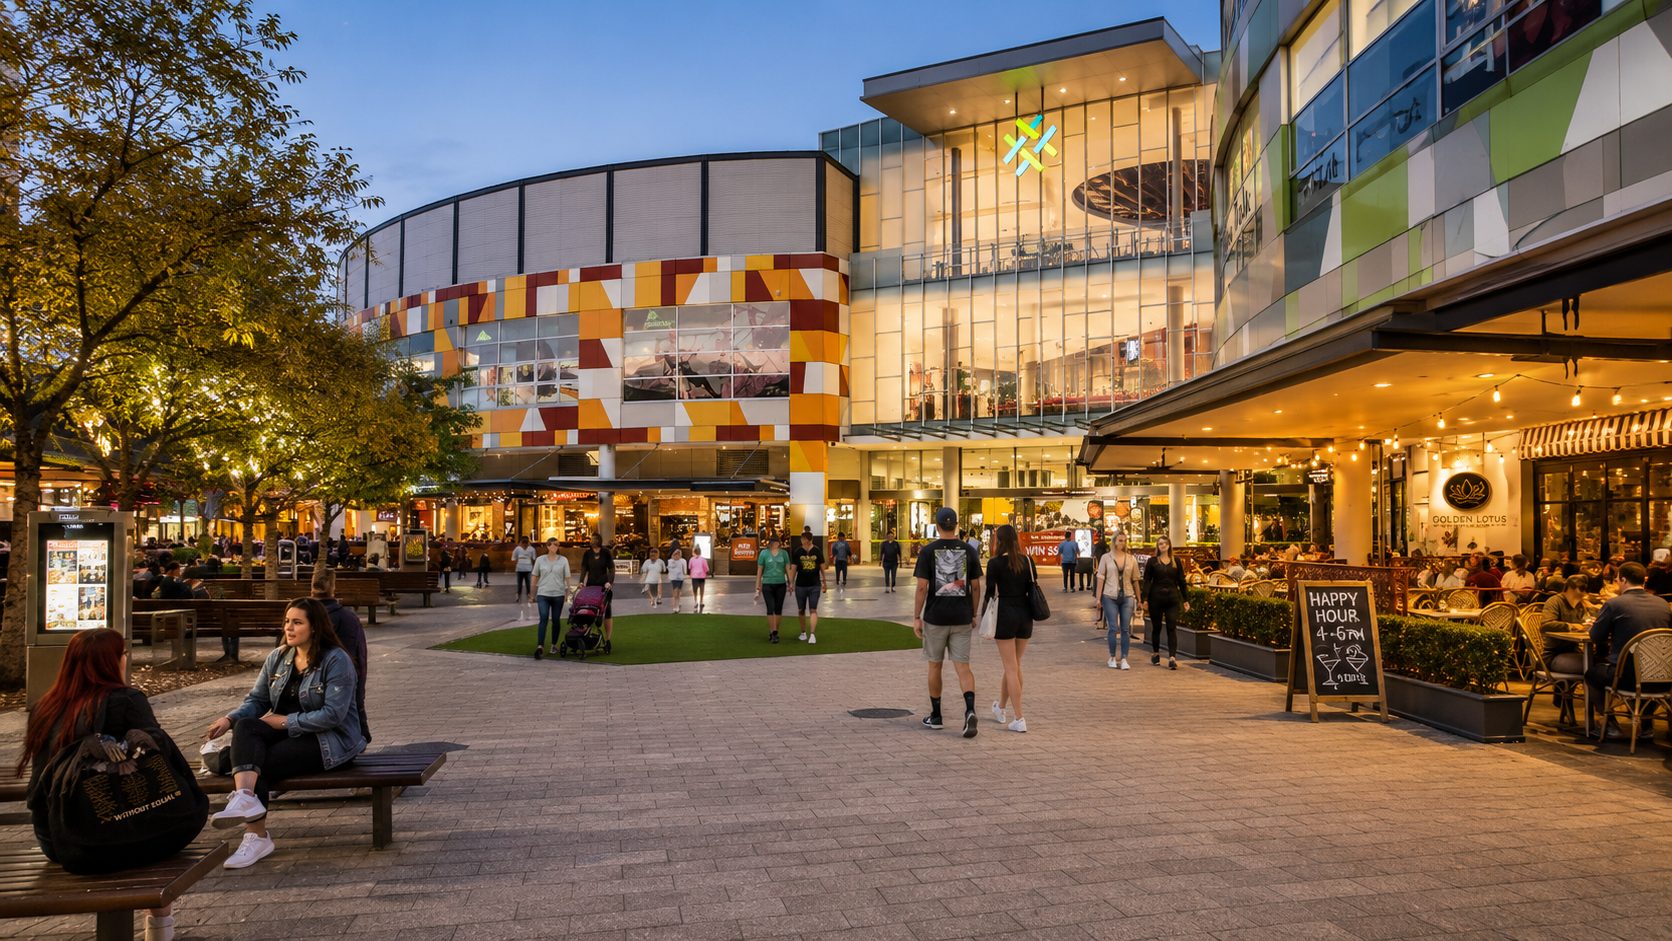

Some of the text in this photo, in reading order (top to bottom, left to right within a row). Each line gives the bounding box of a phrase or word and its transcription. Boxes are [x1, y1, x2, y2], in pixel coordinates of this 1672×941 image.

[1432, 515, 1507, 524] GOLDEN LOTUS
[1025, 545, 1046, 556] WIN
[1309, 591, 1359, 607] HAPPY
[1315, 608, 1361, 623] HOUR
[114, 795, 175, 821] WITHOUT EQUAL
